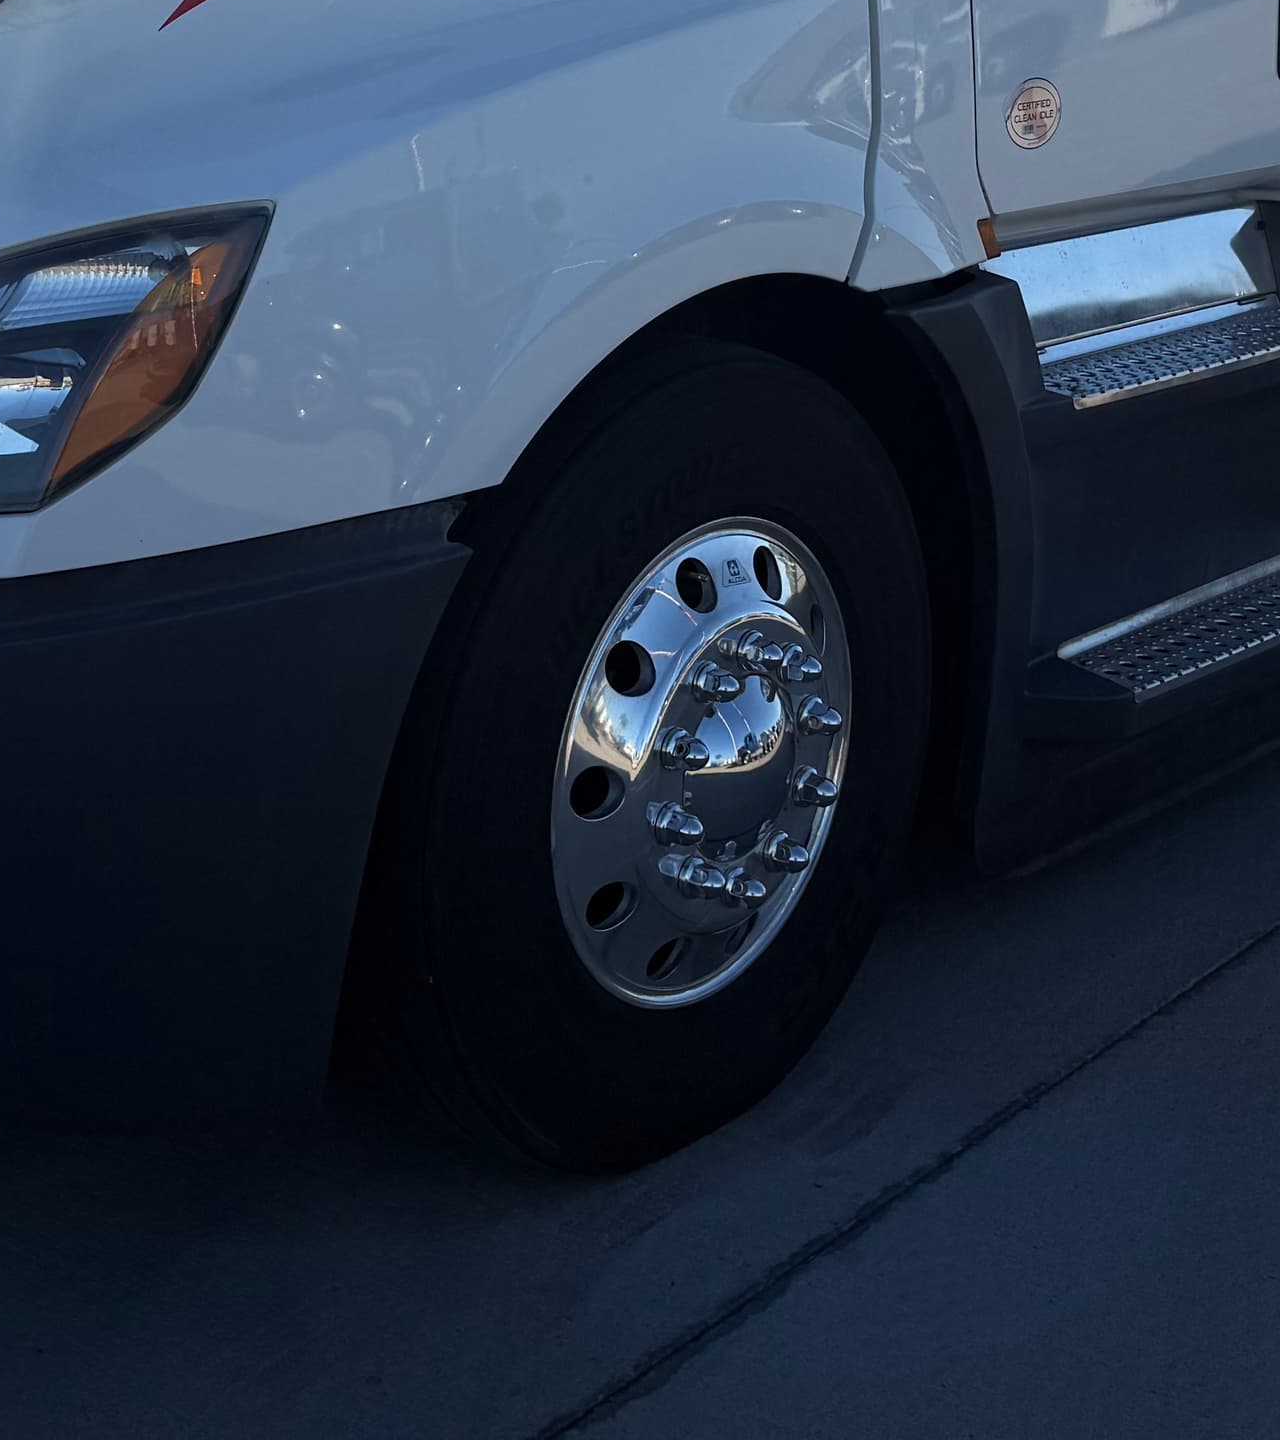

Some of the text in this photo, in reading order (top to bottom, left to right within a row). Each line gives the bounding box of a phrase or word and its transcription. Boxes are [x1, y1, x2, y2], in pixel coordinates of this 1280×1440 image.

[1017, 98, 1051, 111] CERTIFIED
[1014, 109, 1055, 124] CLEAN IDLE
